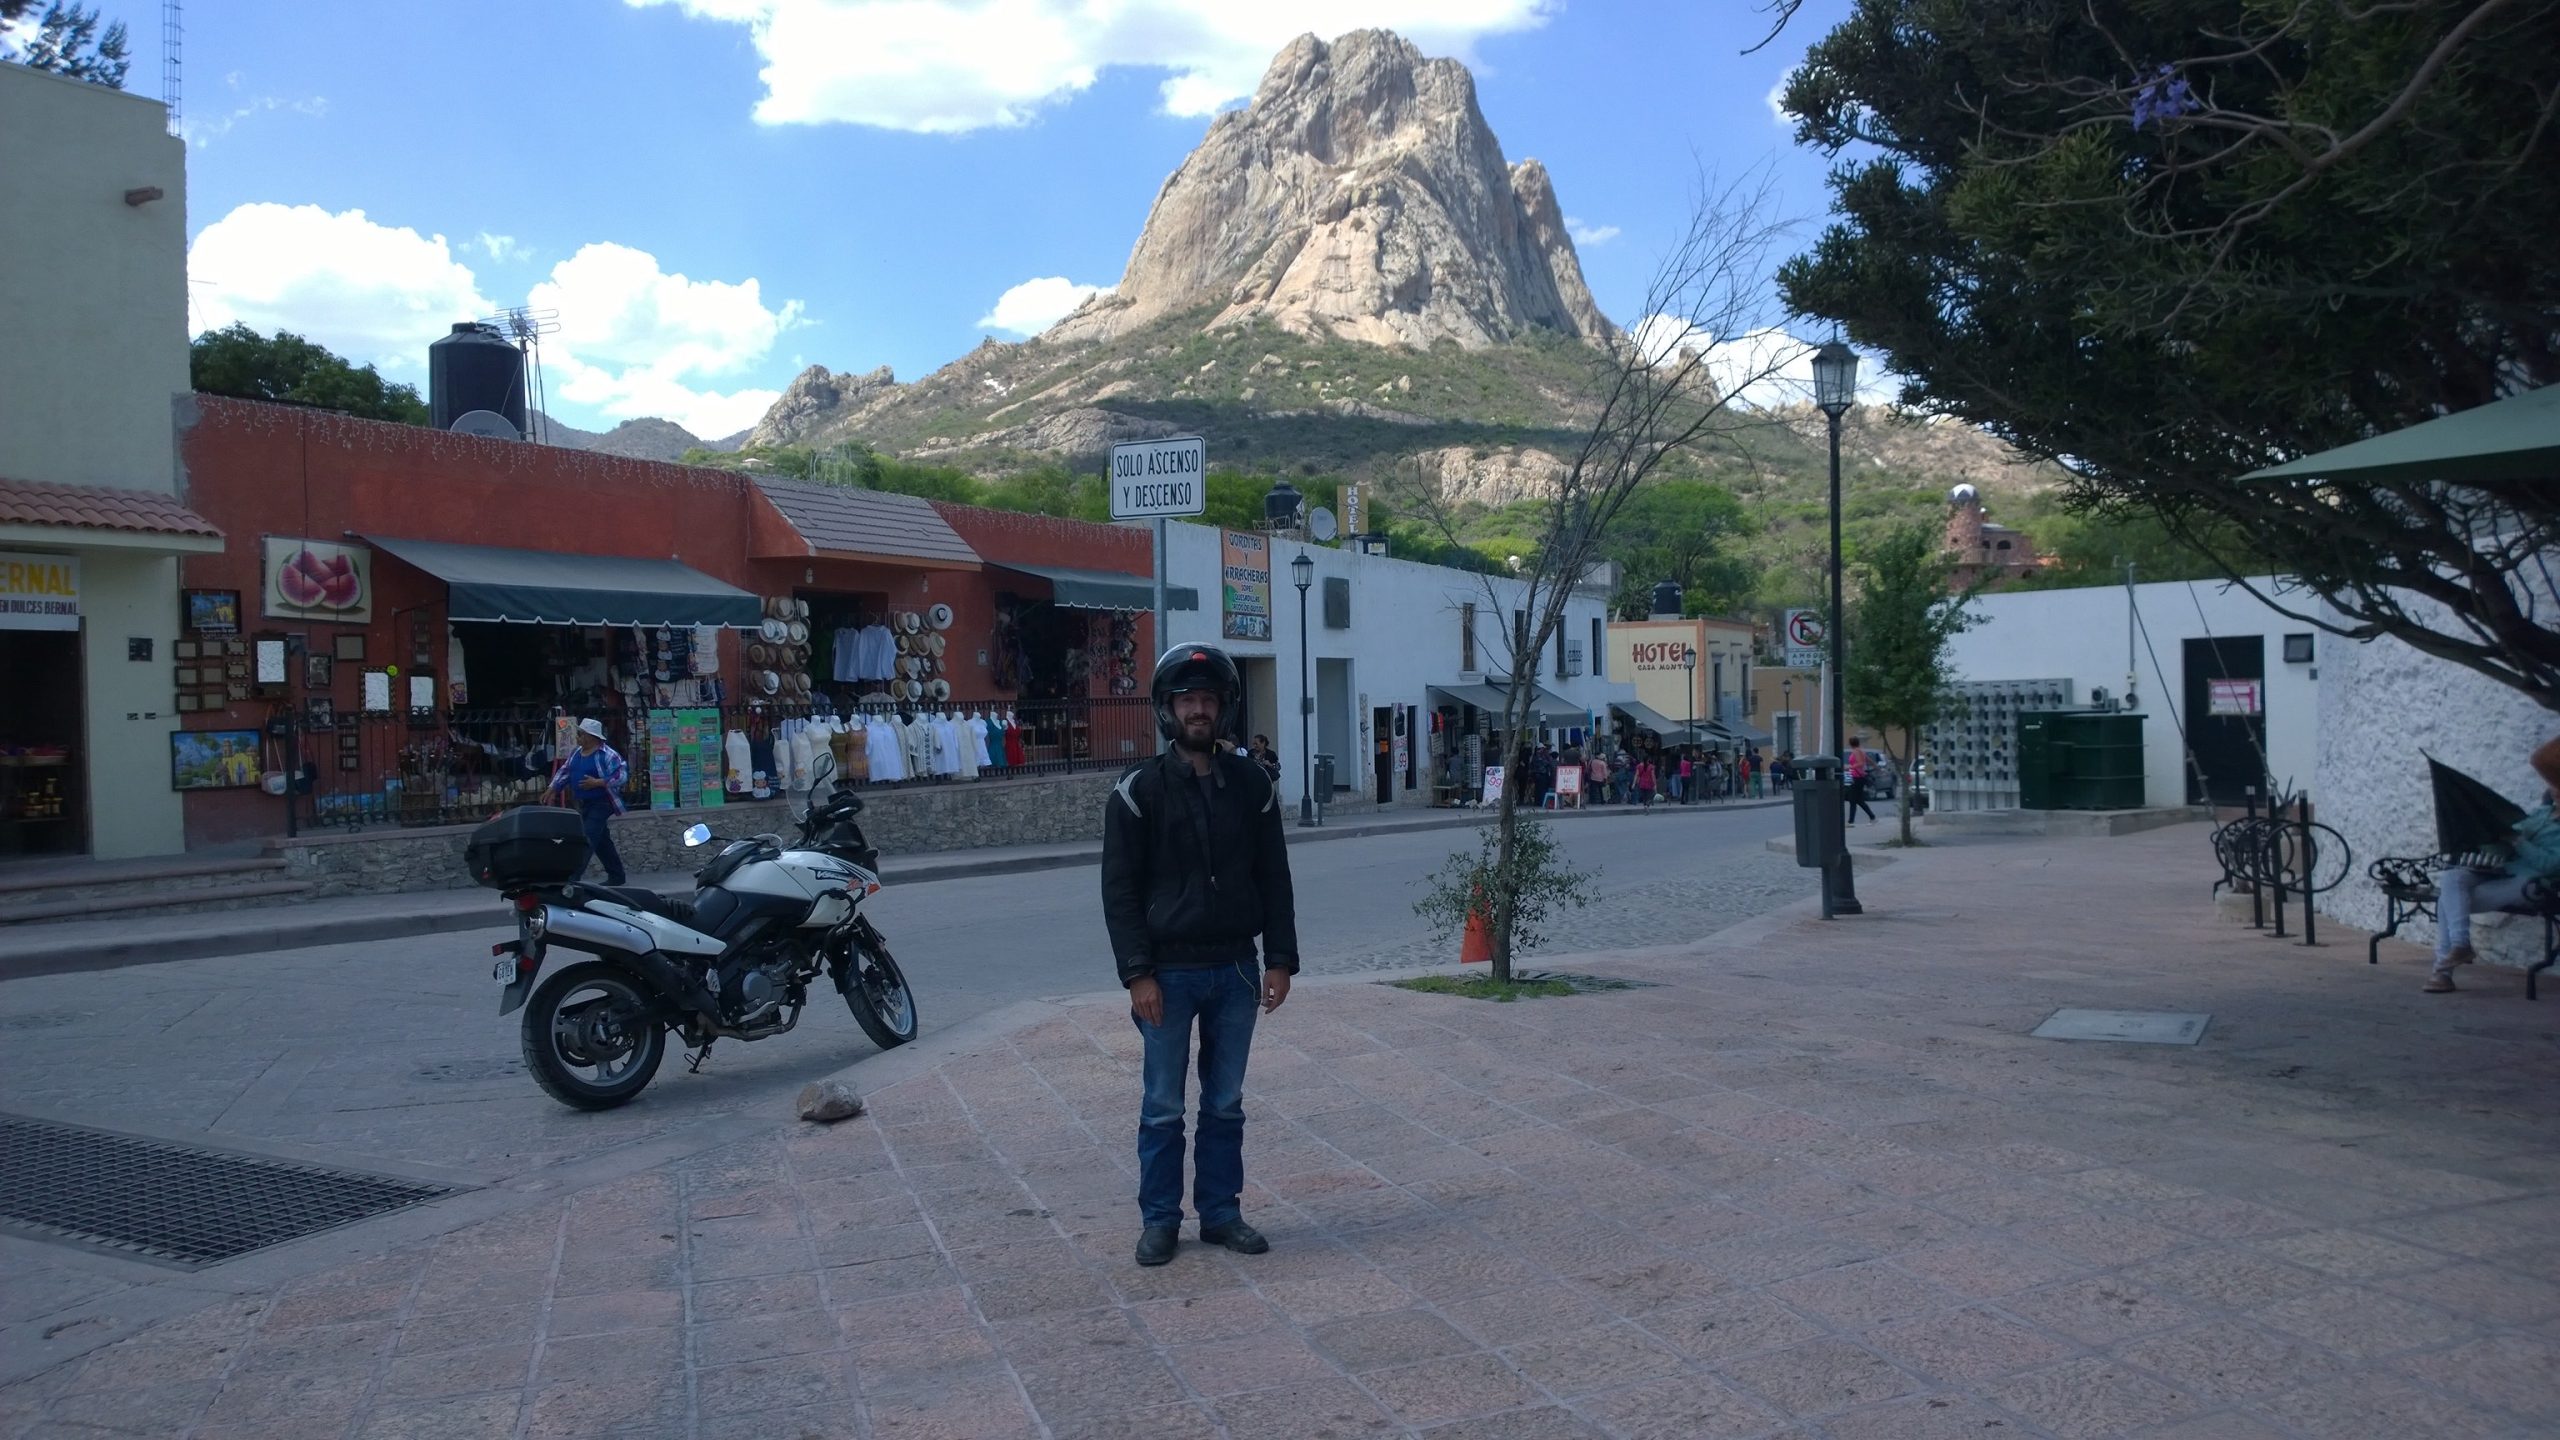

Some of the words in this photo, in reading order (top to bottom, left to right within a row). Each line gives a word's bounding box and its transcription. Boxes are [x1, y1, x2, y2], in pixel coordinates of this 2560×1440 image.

[1116, 453, 1143, 478] SOLO
[1147, 448, 1199, 476] ASCENSO
[1122, 486, 1130, 509] Y
[1135, 481, 1192, 508] DESCENSO
[1347, 486, 1359, 534] HOTEL
[1229, 533, 1262, 551] GORDITAS
[1244, 551, 1249, 566] Y
[1225, 566, 1269, 583] ARRACHERAS
[10, 600, 43, 615] DULCES
[44, 600, 79, 616] BERNAL
[1631, 642, 1688, 663] HOTEL
